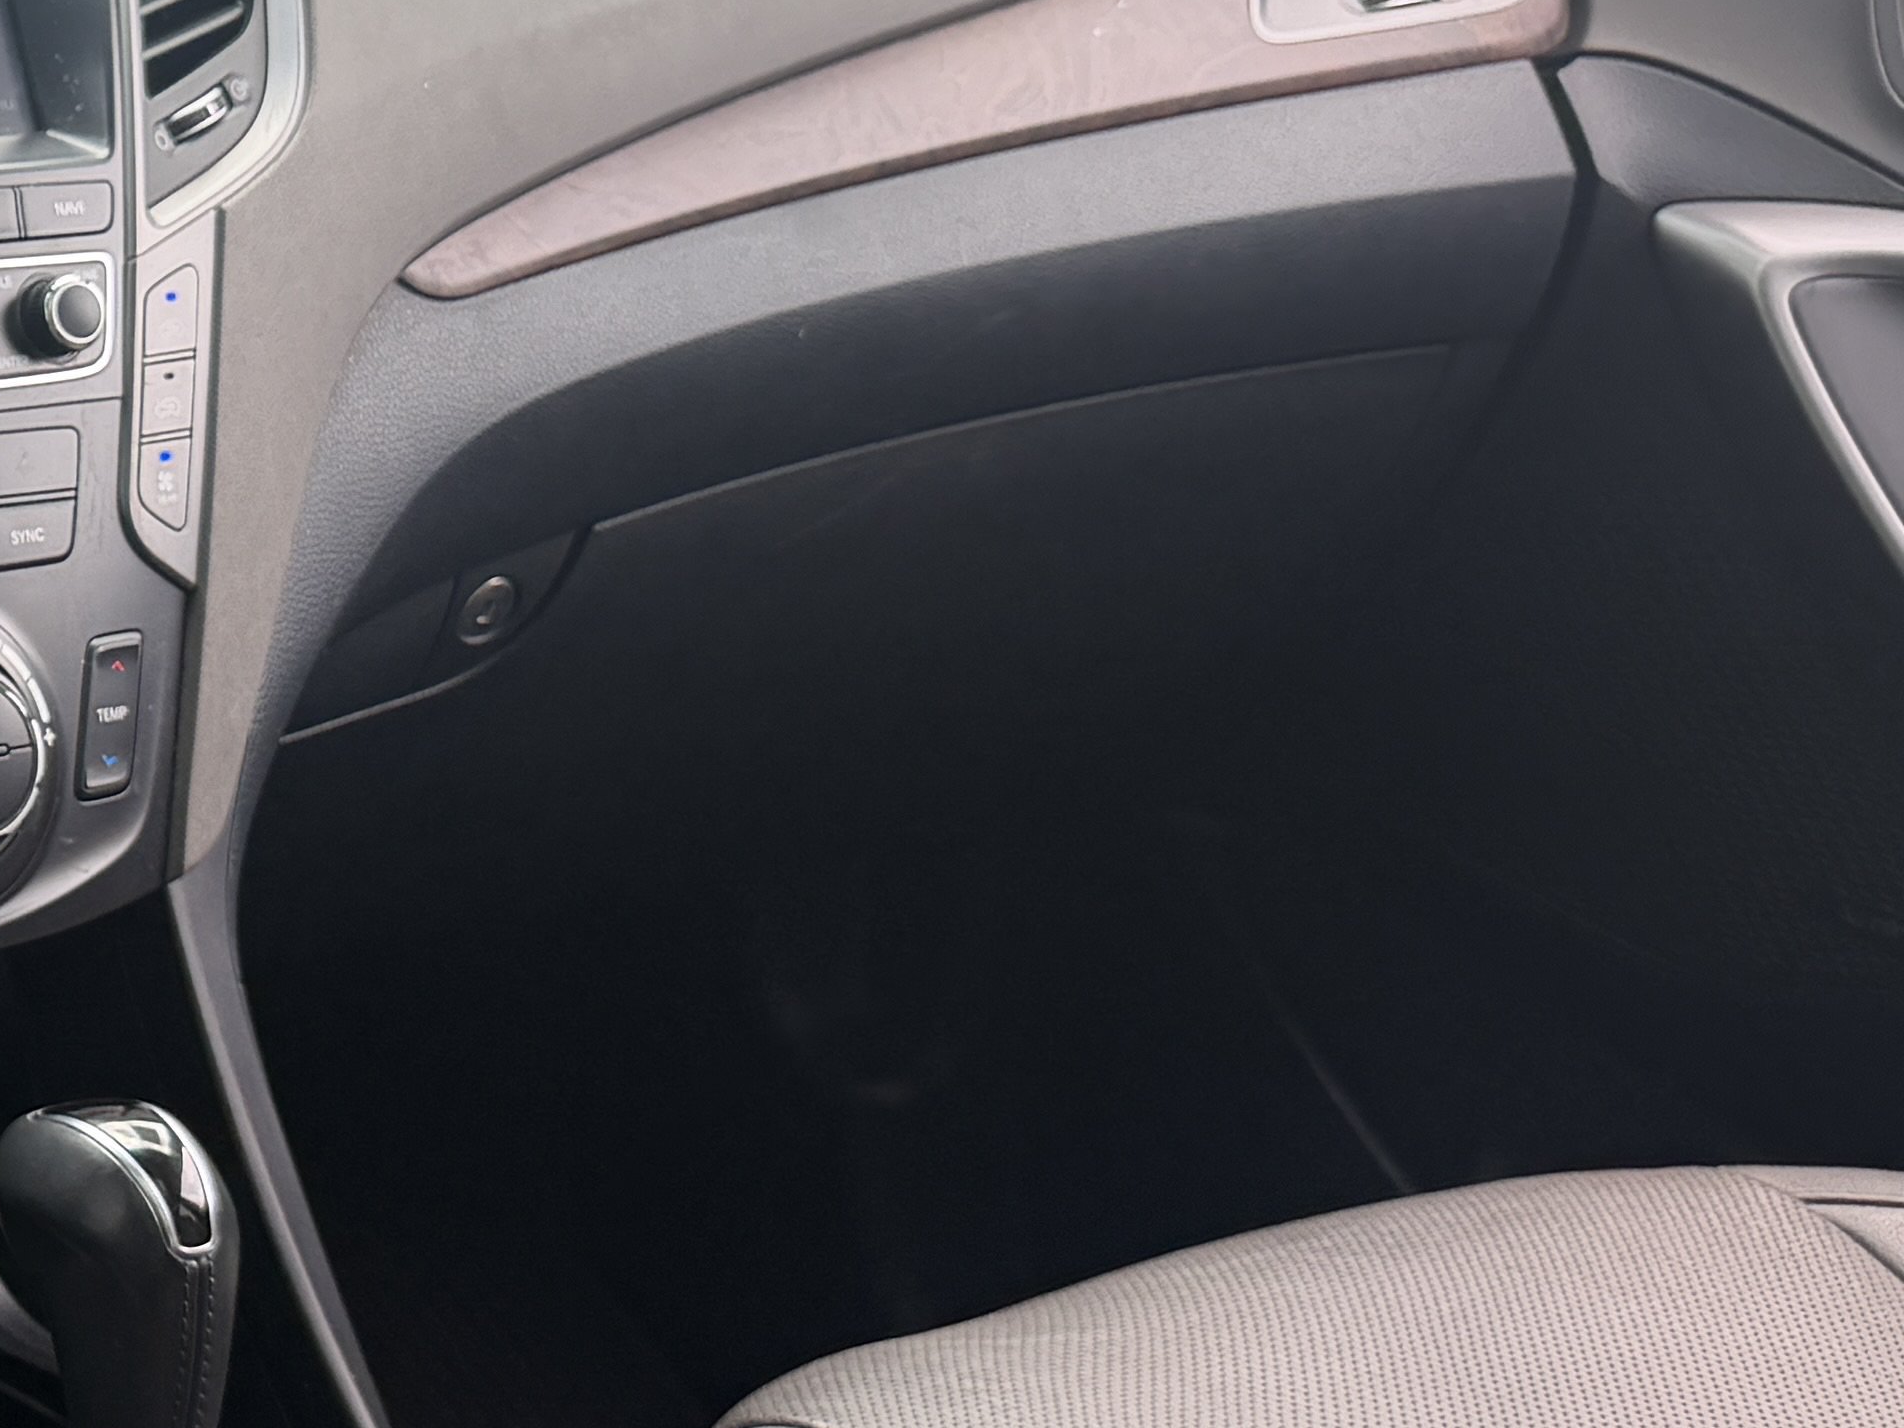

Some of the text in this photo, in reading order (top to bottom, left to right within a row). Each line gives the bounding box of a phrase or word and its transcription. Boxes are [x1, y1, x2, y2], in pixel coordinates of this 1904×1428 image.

[53, 200, 86, 217] NAVI
[10, 526, 46, 546] SYNC
[95, 704, 129, 724] TEMP
